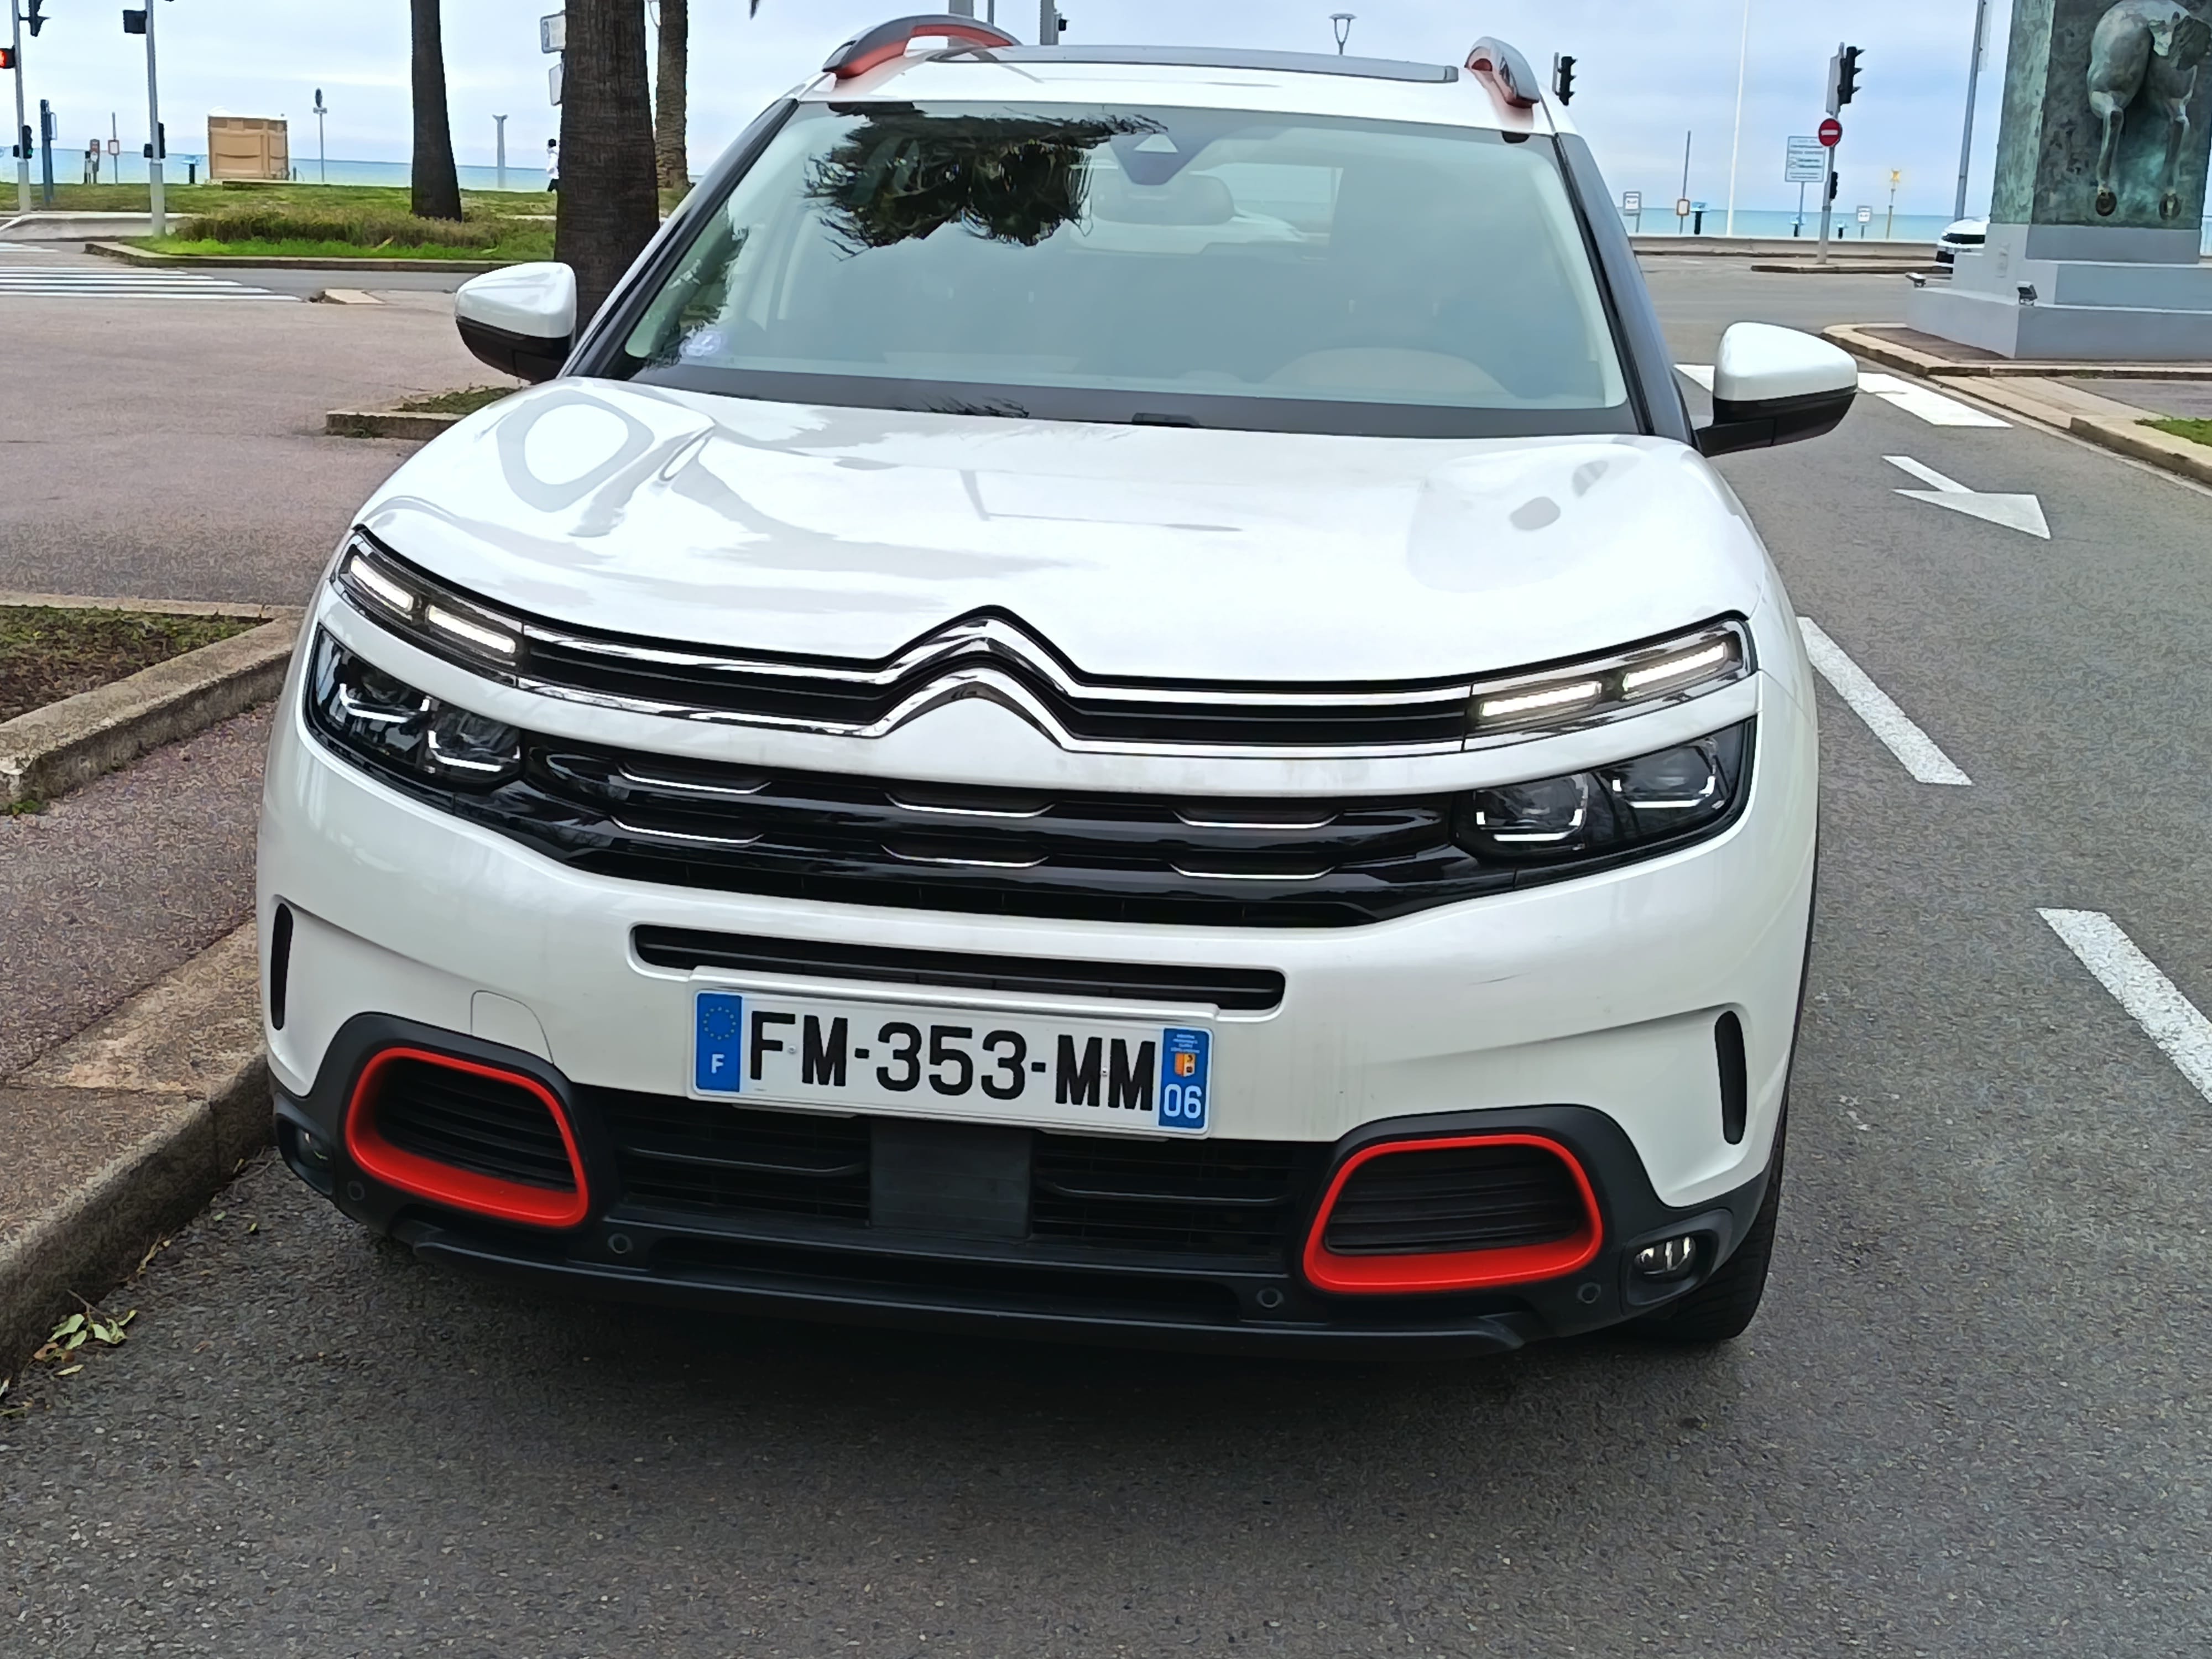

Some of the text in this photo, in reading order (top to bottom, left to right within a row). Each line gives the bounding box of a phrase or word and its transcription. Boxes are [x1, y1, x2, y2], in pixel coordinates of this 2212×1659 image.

[711, 1053, 725, 1074] F
[750, 1010, 1156, 1111] FM-353-MM
[1164, 1083, 1202, 1119] 06
